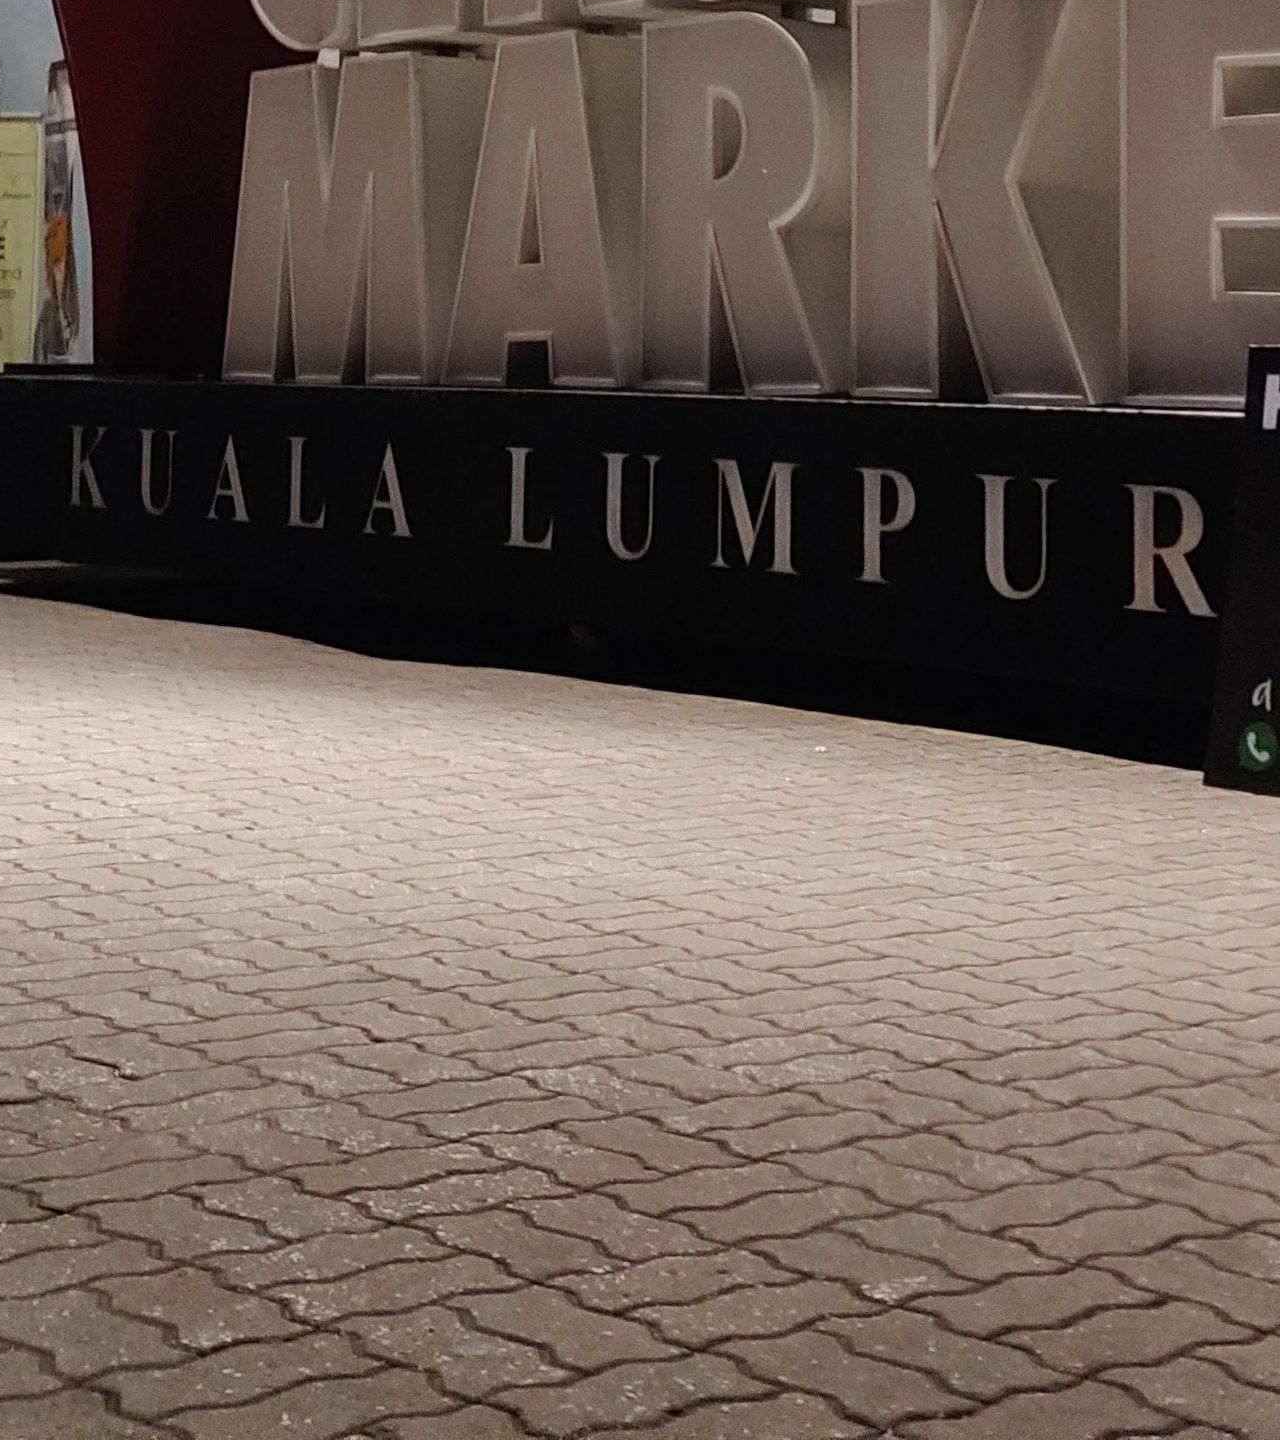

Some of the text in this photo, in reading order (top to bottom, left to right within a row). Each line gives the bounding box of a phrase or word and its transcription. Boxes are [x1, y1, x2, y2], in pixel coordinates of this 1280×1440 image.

[68, 423, 1220, 620] KUALA LUMPUR
[1251, 678, 1272, 712] a
